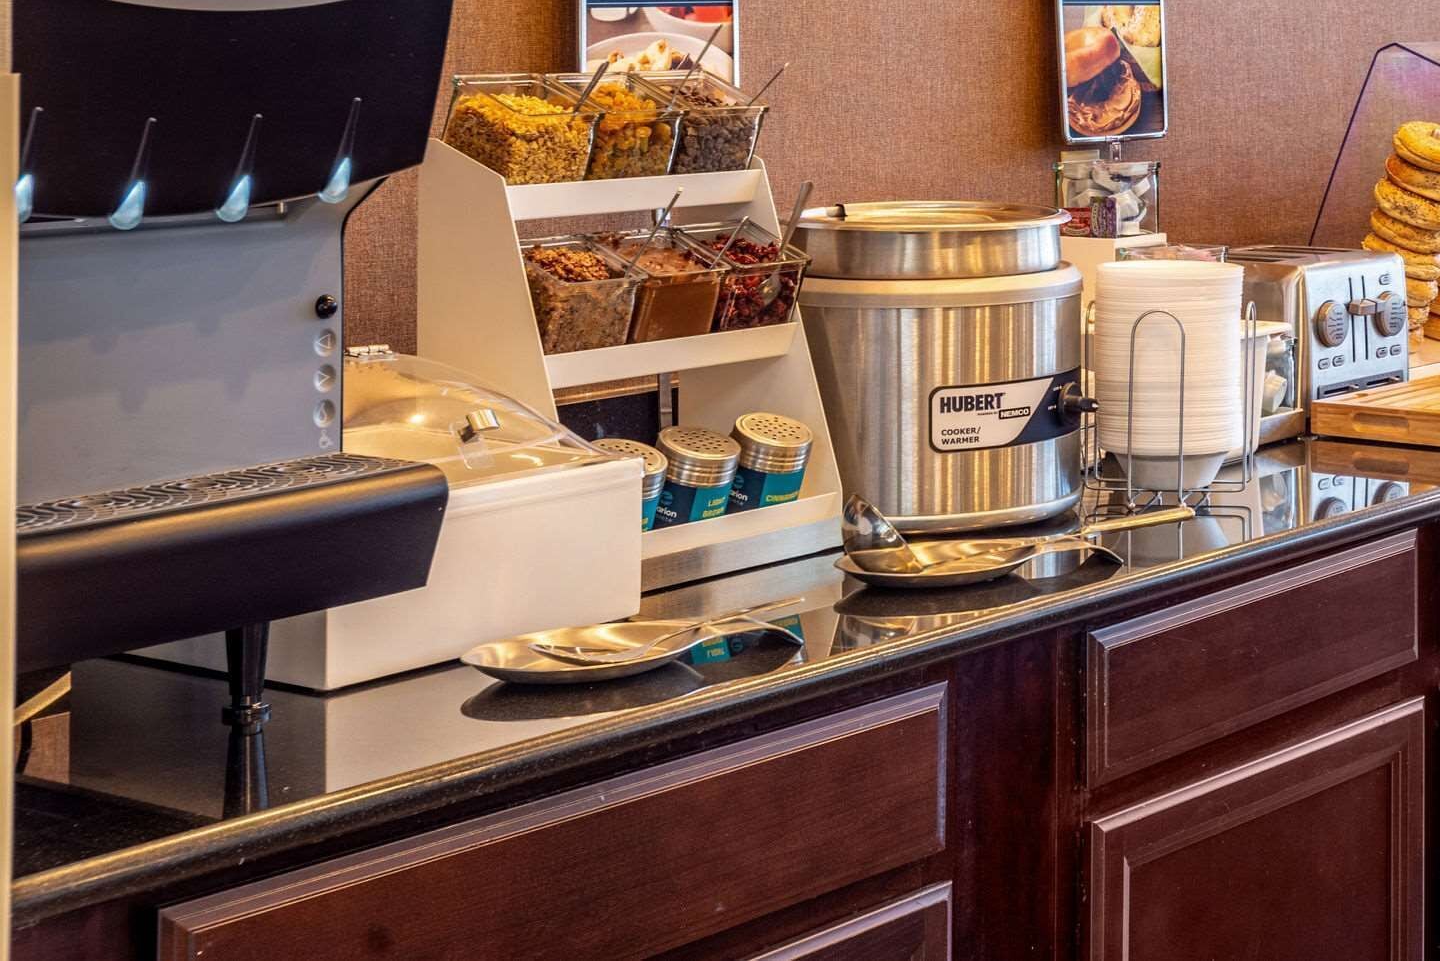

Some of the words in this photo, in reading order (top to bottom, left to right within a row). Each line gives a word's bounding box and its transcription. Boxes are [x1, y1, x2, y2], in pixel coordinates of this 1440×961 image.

[940, 392, 1006, 414] HUBERT
[1000, 407, 1030, 419] NEMCO
[941, 426, 982, 437] COOKER/
[941, 436, 980, 446] WARMER
